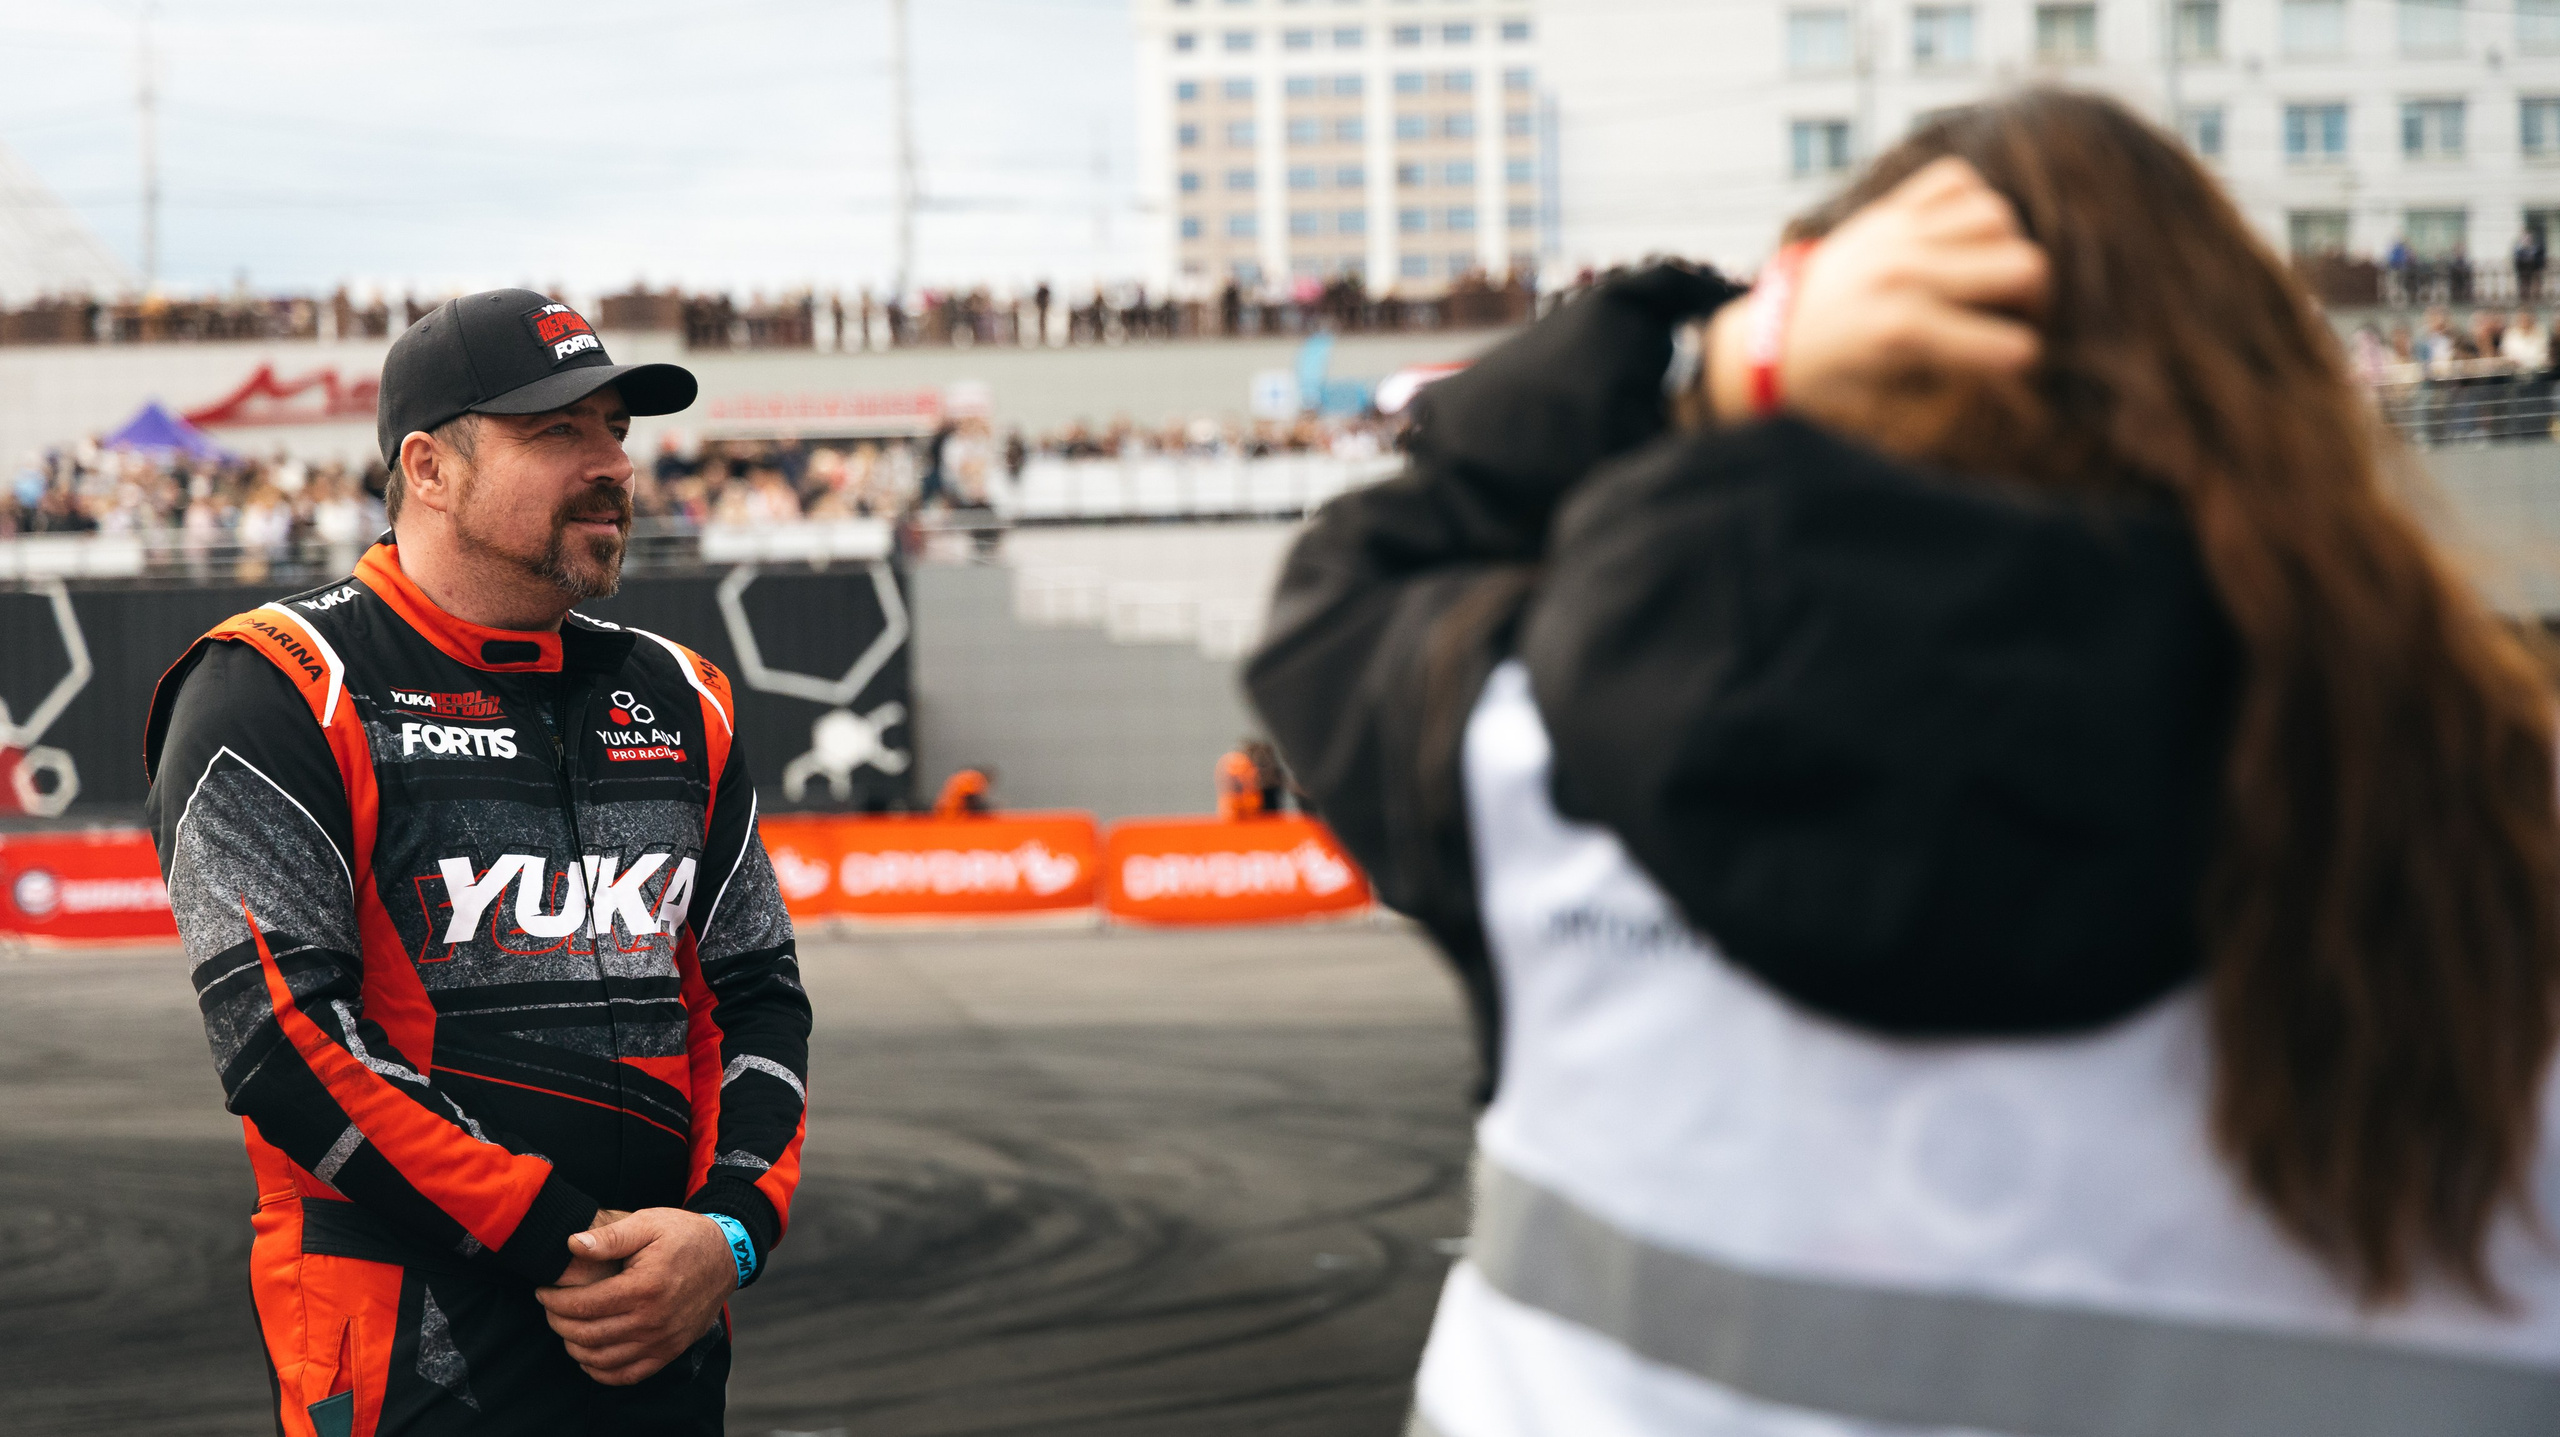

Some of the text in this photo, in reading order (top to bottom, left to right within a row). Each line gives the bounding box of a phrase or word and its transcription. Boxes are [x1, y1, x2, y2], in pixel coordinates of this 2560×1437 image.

[298, 586, 361, 610] YUKA
[238, 618, 324, 682] MARINA
[390, 691, 436, 707] YUKA
[402, 722, 518, 759] FORTIS
[596, 730, 648, 746] YUKA
[612, 750, 636, 760] PRO
[437, 853, 698, 944] YUKA
